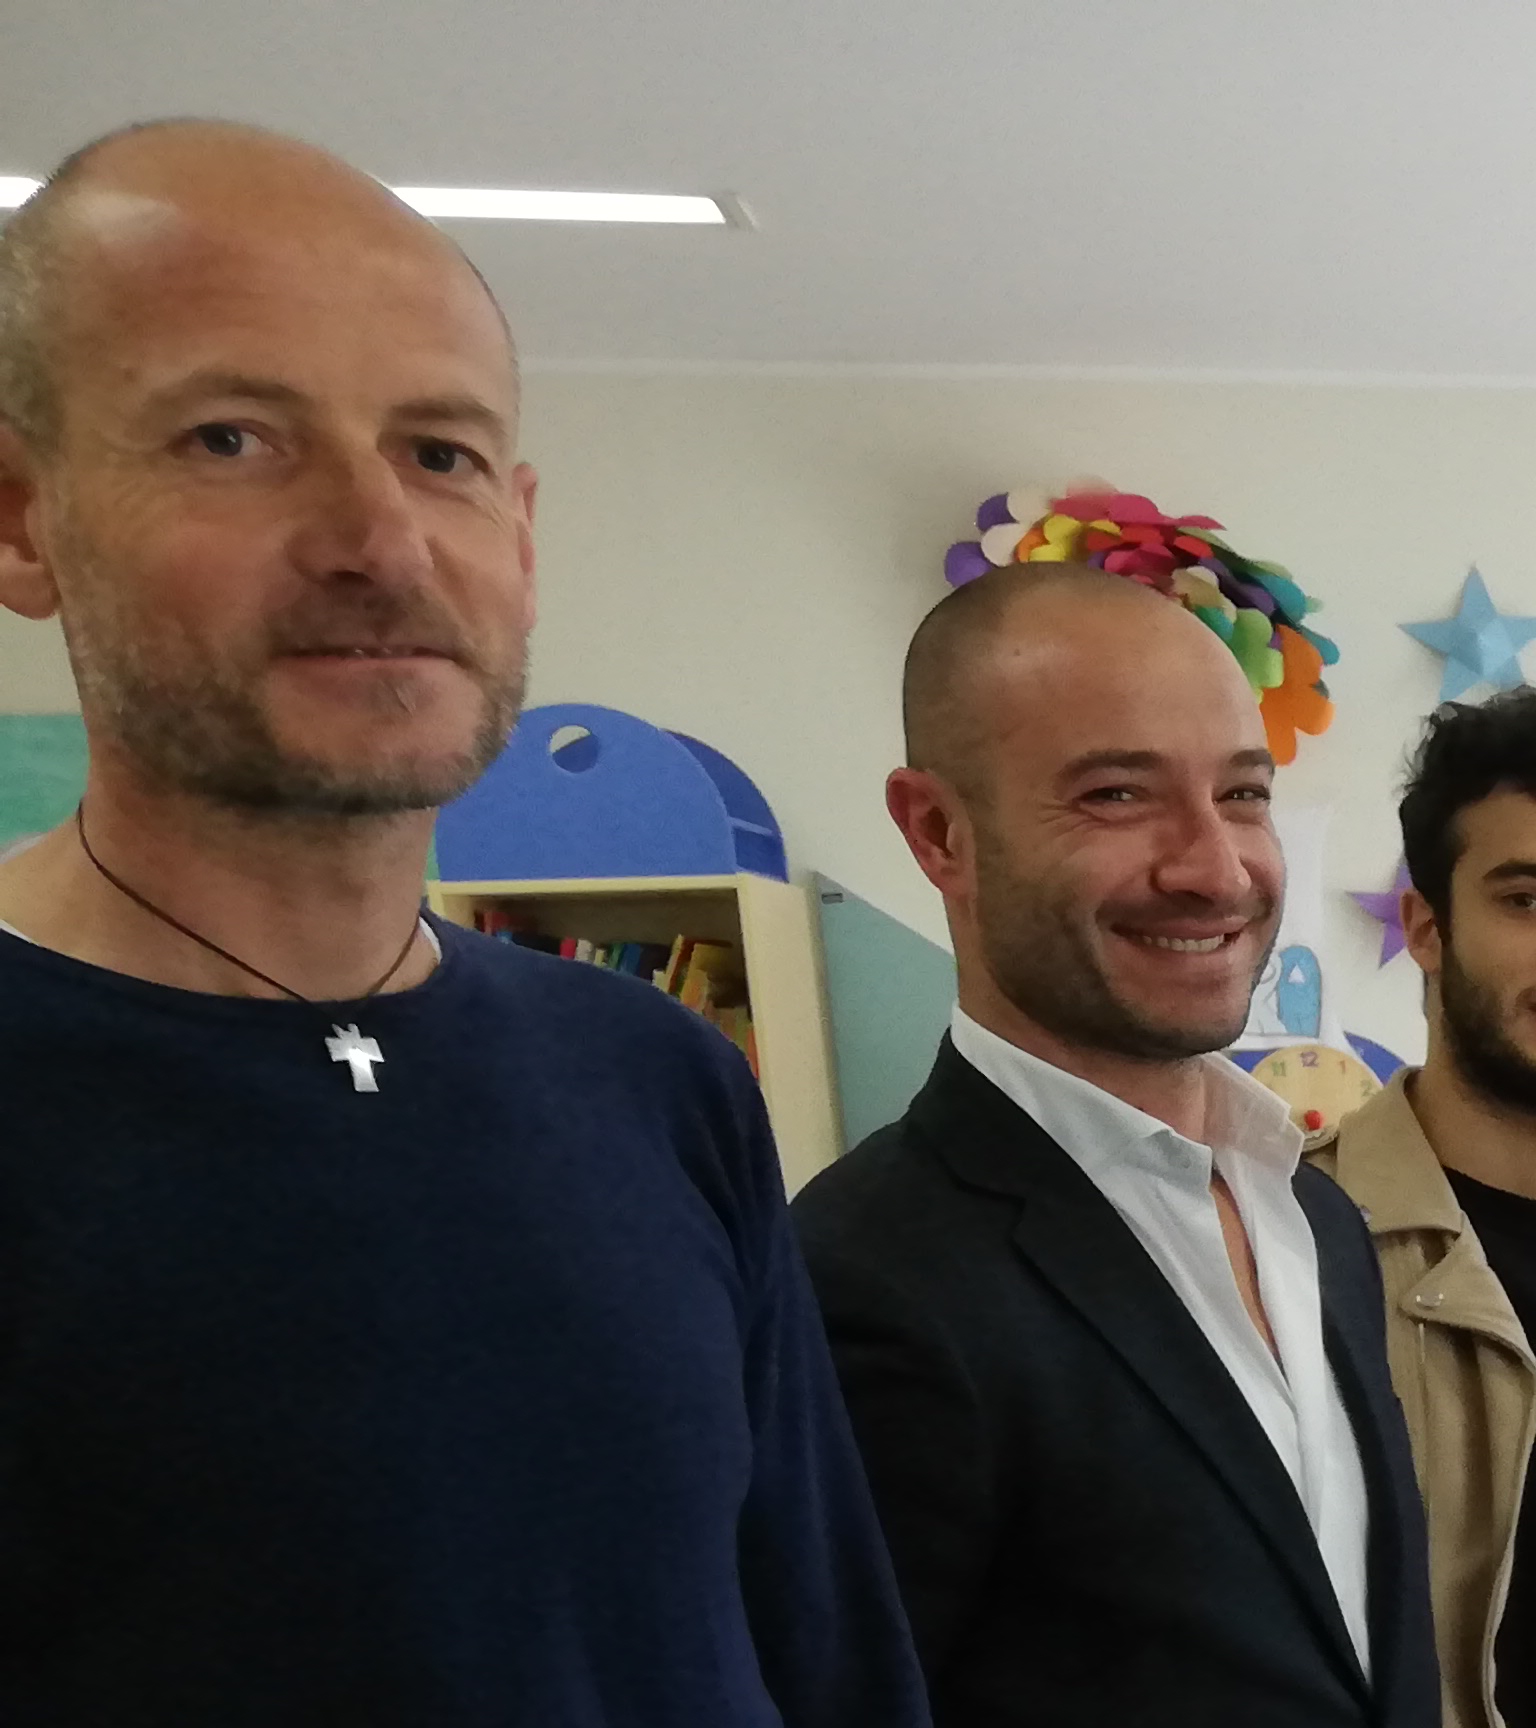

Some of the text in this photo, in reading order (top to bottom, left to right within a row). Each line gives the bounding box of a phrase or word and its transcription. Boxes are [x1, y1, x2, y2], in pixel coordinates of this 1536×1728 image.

[1300, 1051, 1319, 1068] 12
[1339, 1060, 1347, 1075] 1
[1271, 1060, 1287, 1077] 11
[1360, 1079, 1374, 1097] 2
